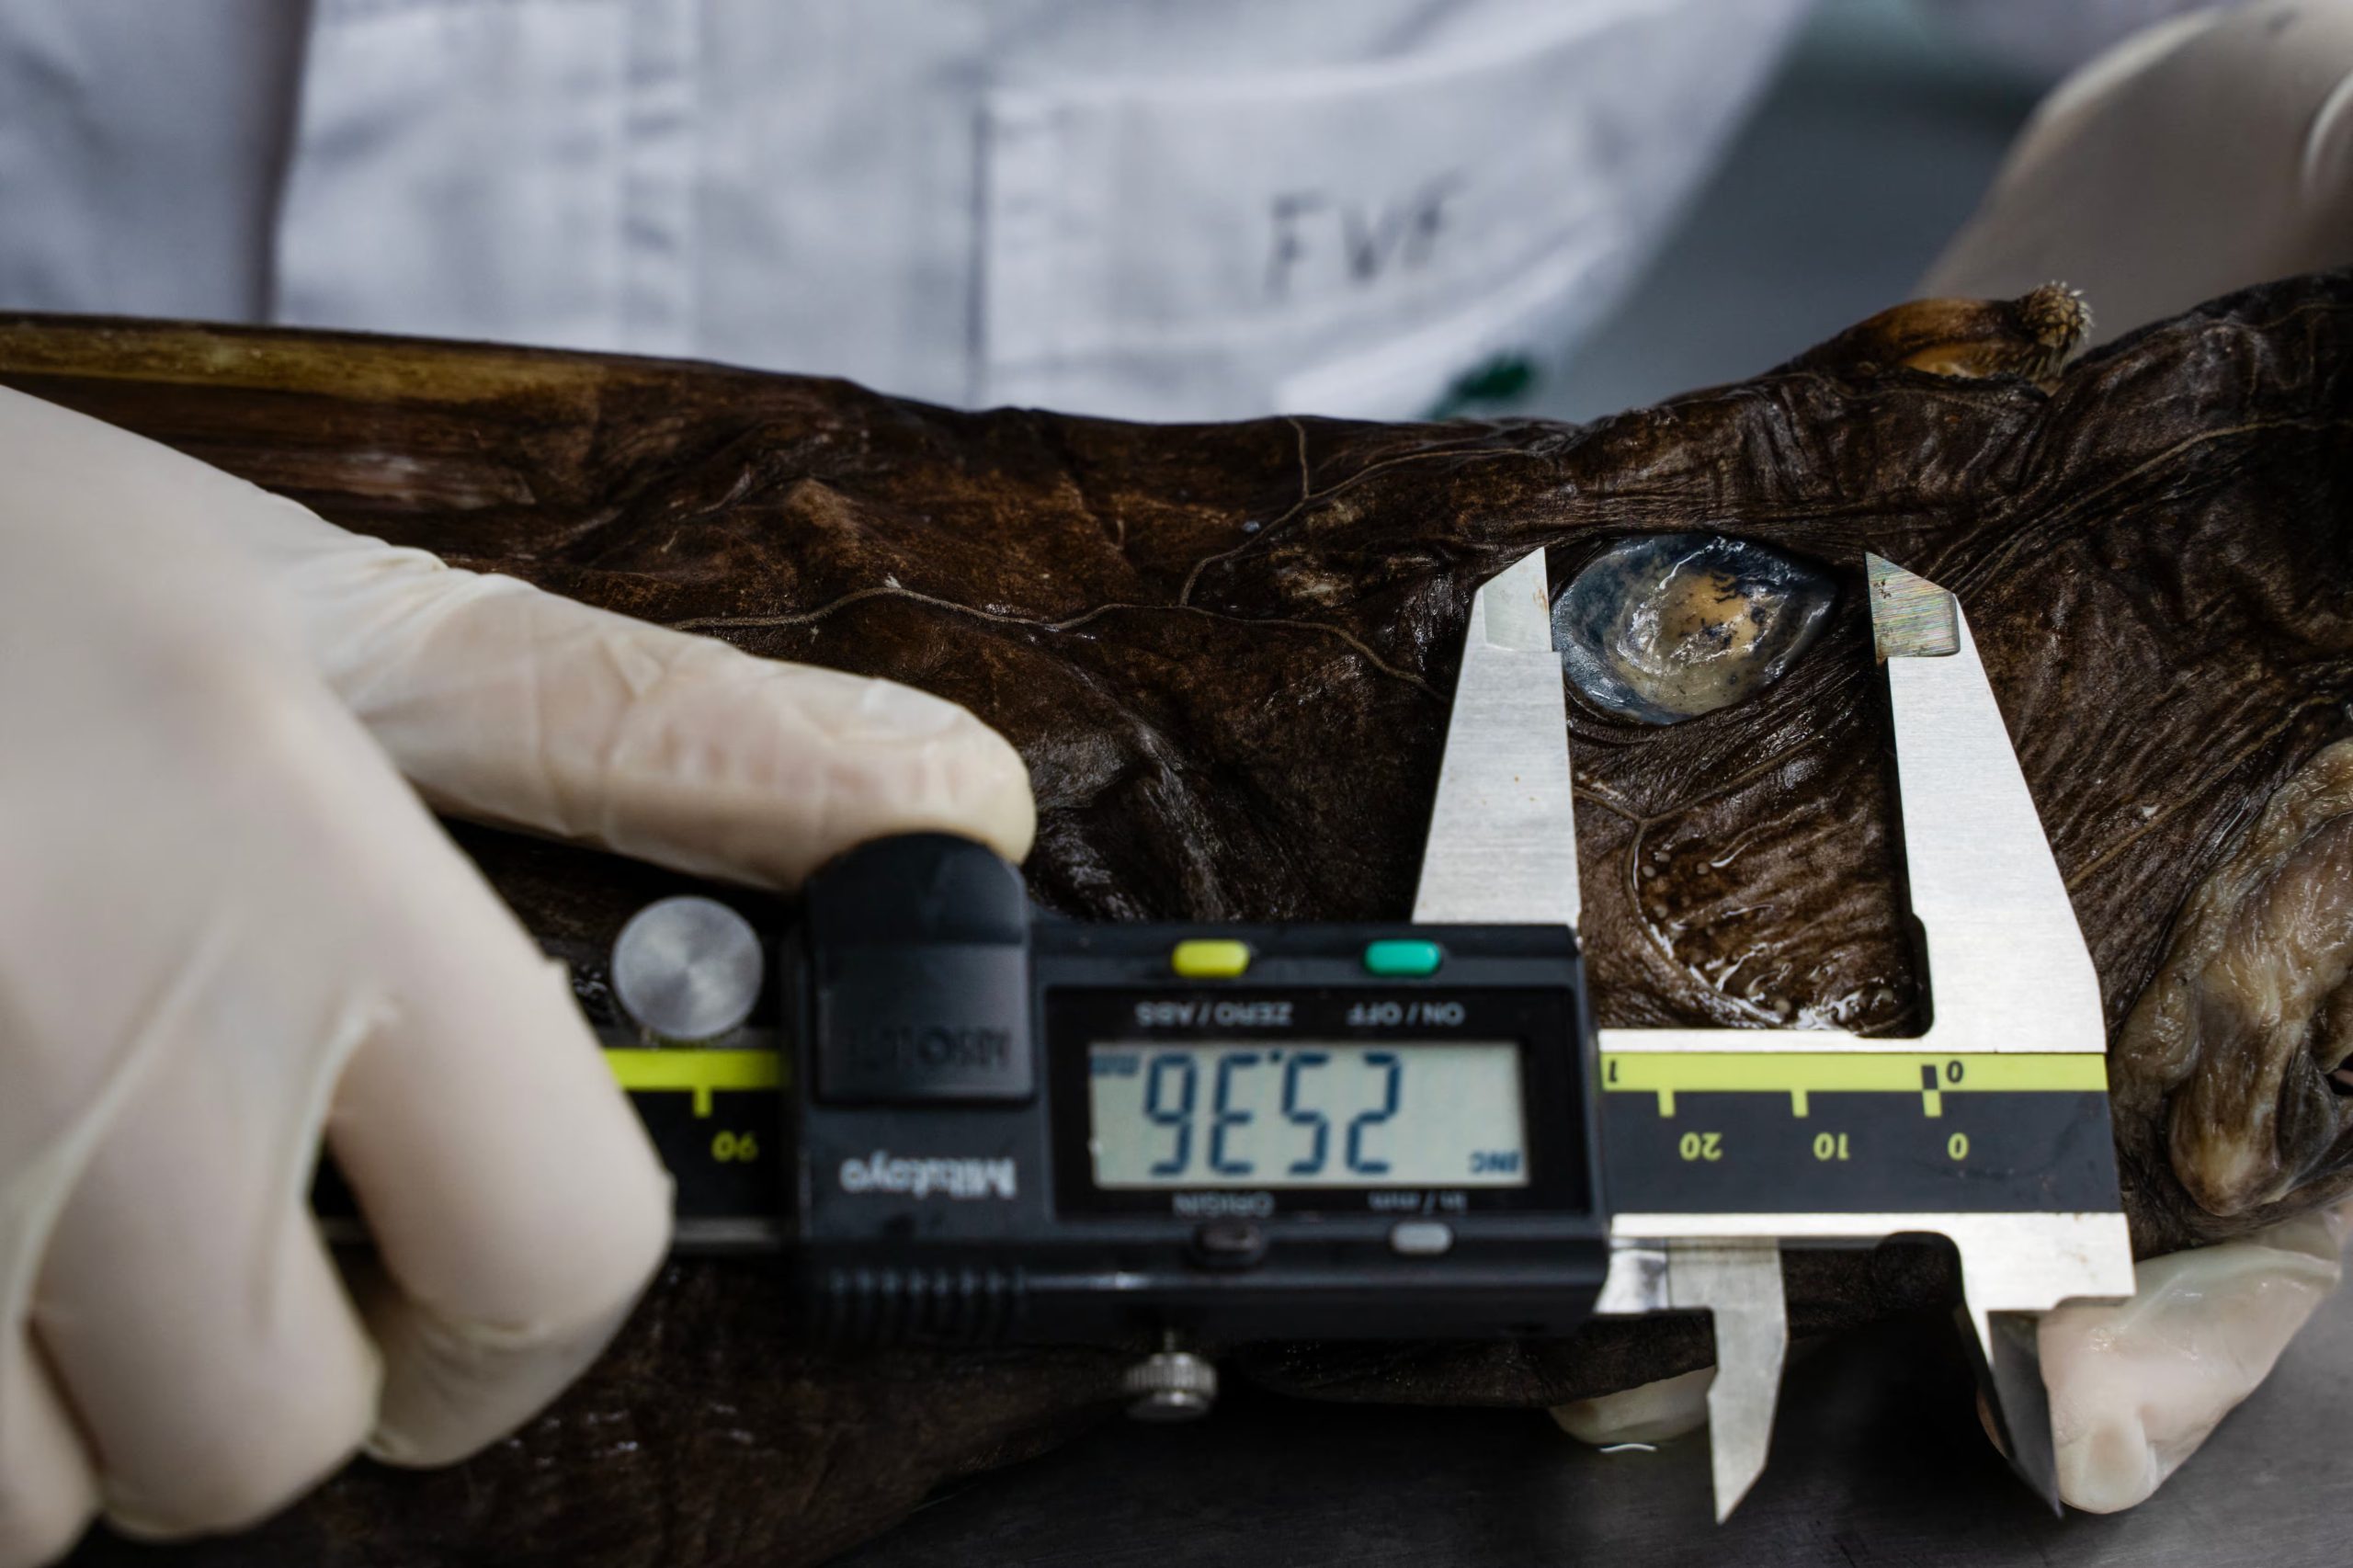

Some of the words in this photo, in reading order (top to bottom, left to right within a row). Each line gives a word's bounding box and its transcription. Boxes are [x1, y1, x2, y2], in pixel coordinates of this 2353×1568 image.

[1946, 1060, 1964, 1084] 0
[1144, 1050, 1403, 1176] 25.36
[1678, 1132, 1722, 1161] 20
[1813, 1132, 1850, 1160] 10
[1947, 1132, 1969, 1160] 0
[840, 1149, 1017, 1199] Mitutoyo
[1470, 1151, 1520, 1176] INC
